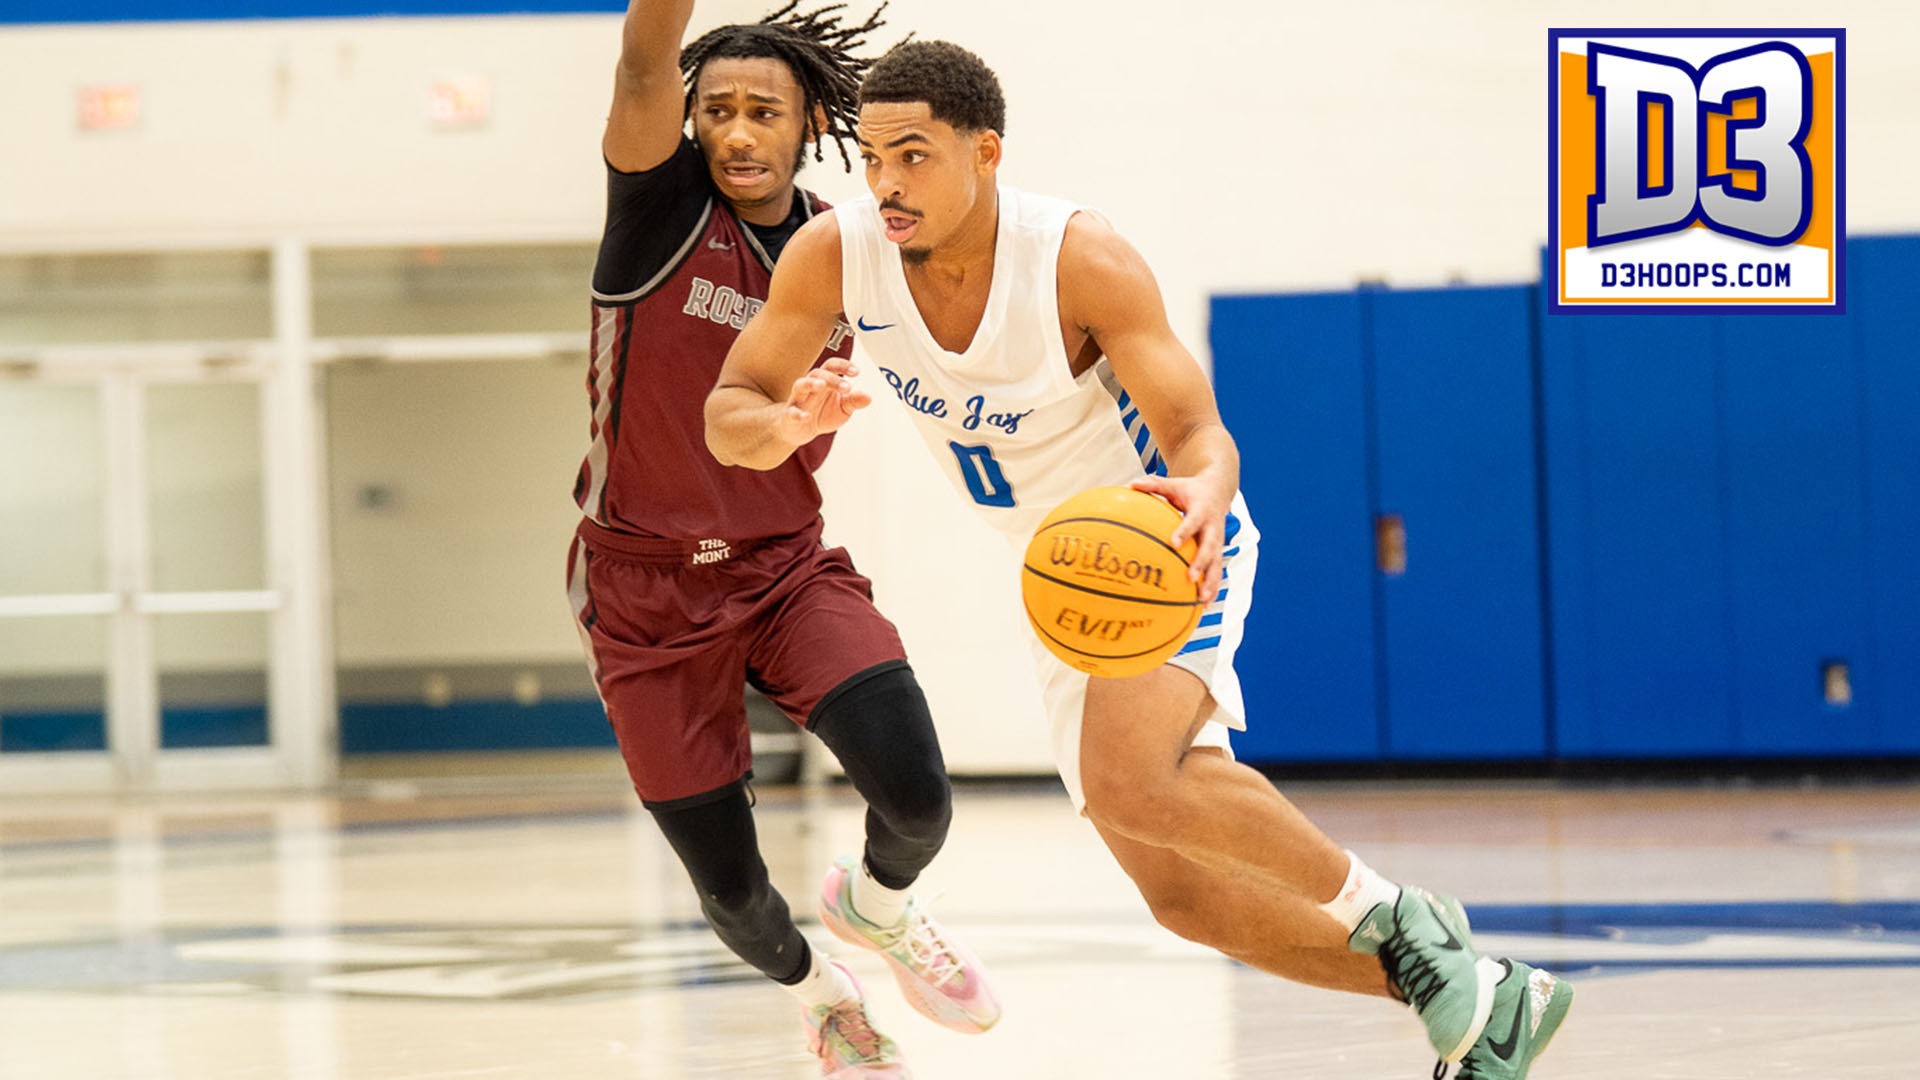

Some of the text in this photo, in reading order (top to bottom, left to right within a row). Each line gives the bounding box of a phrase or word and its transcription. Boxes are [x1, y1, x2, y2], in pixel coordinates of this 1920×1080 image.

[683, 277, 855, 352] ROSET
[962, 395, 1035, 434] Jay
[949, 440, 1016, 508] 0
[692, 546, 731, 565] MONT
[698, 538, 727, 550] THE
[1050, 536, 1167, 591] Wilson
[1056, 607, 1128, 641] EVO
